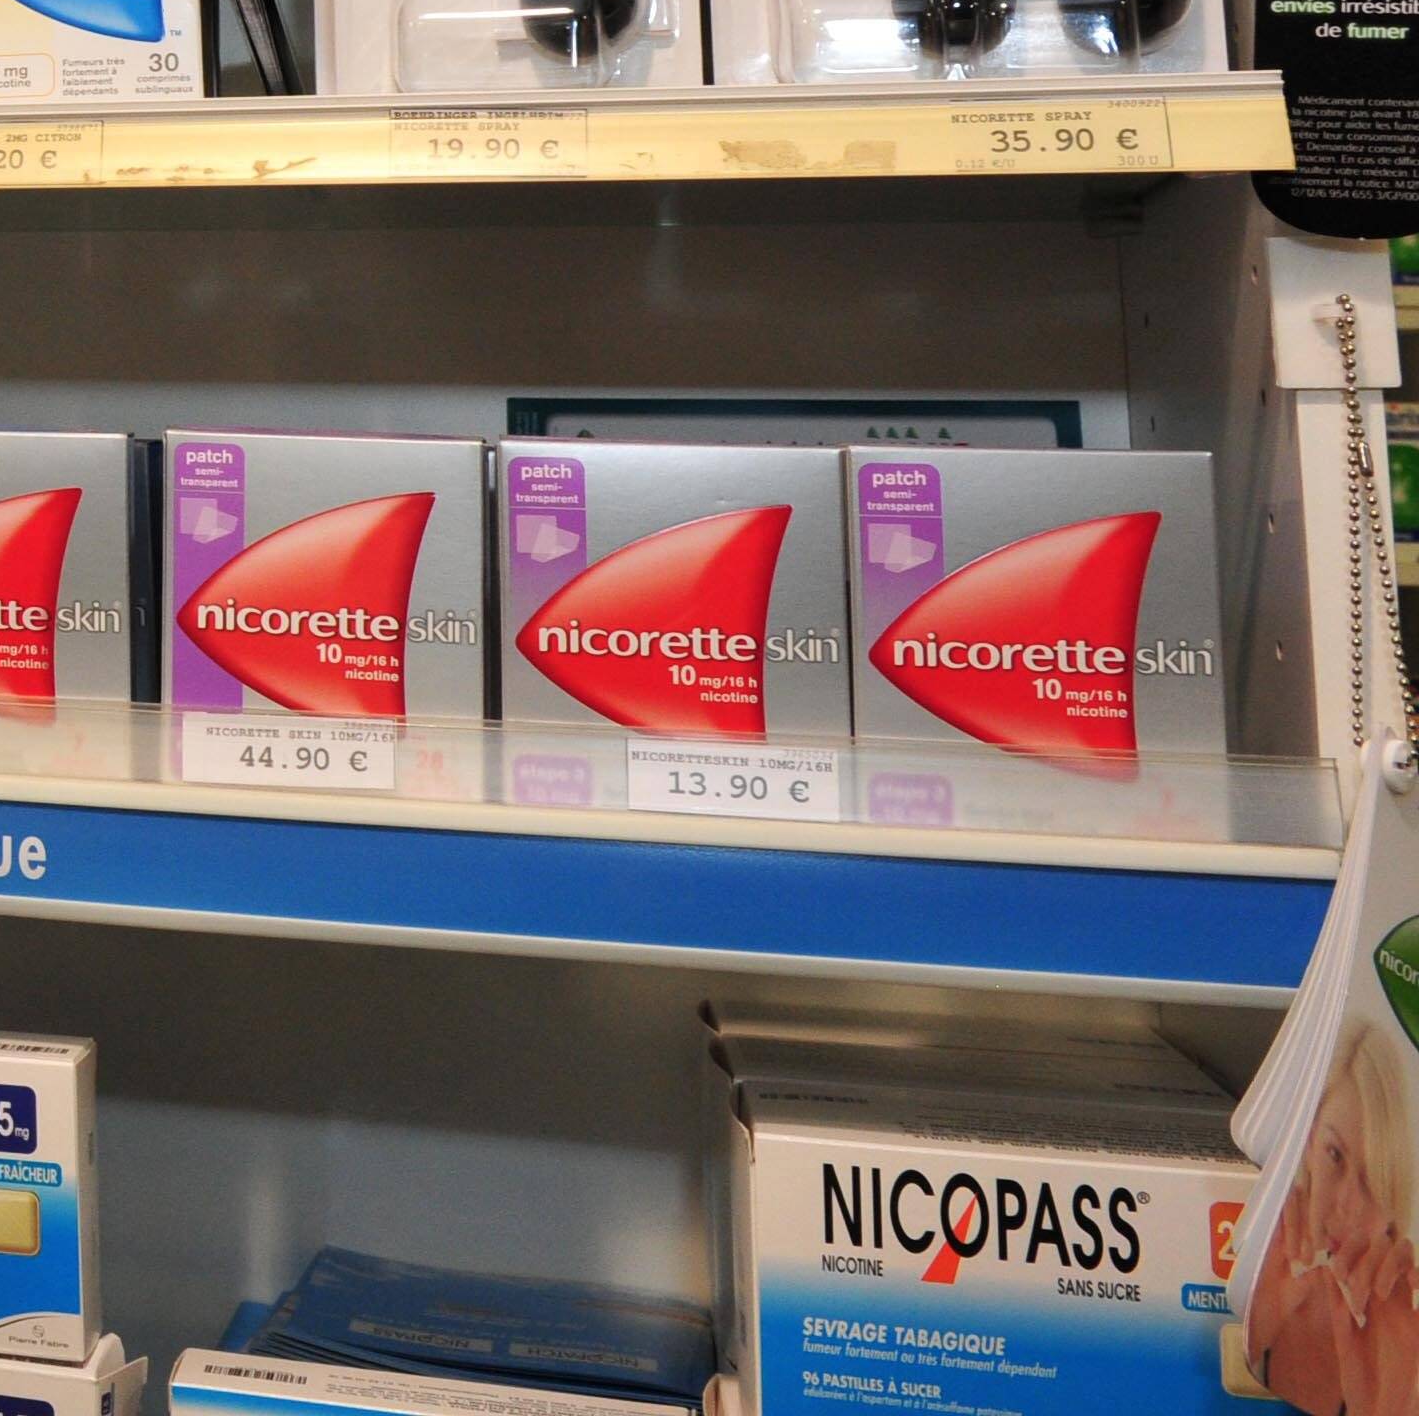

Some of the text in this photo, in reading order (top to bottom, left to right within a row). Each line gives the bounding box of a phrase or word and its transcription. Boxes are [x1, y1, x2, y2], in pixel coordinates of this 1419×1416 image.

[1315, 21, 1408, 40] de fumer
[148, 53, 179, 72] 30
[951, 110, 1092, 125] NICORETTE SPRAY
[5, 133, 30, 143] 2MG
[34, 132, 82, 142] CITRON
[990, 128, 1138, 152] 35.90 €
[40, 151, 56, 170] €
[57, 601, 120, 633] skin
[197, 602, 475, 644] nicorette skin
[893, 632, 1211, 676] nicorette skin
[631, 750, 834, 774] NICORETTESKIN 10MG/16H
[668, 770, 810, 804] 13.90 €
[0, 1164, 58, 1184] FRAÎCHEUR
[822, 1163, 1140, 1273] NICOPASS
[821, 1255, 883, 1278] NICOTINE
[802, 1317, 1006, 1357] SEVRAGE TABAGIQUE
[802, 1372, 941, 1399] 96 PASTILLES À SUCER
